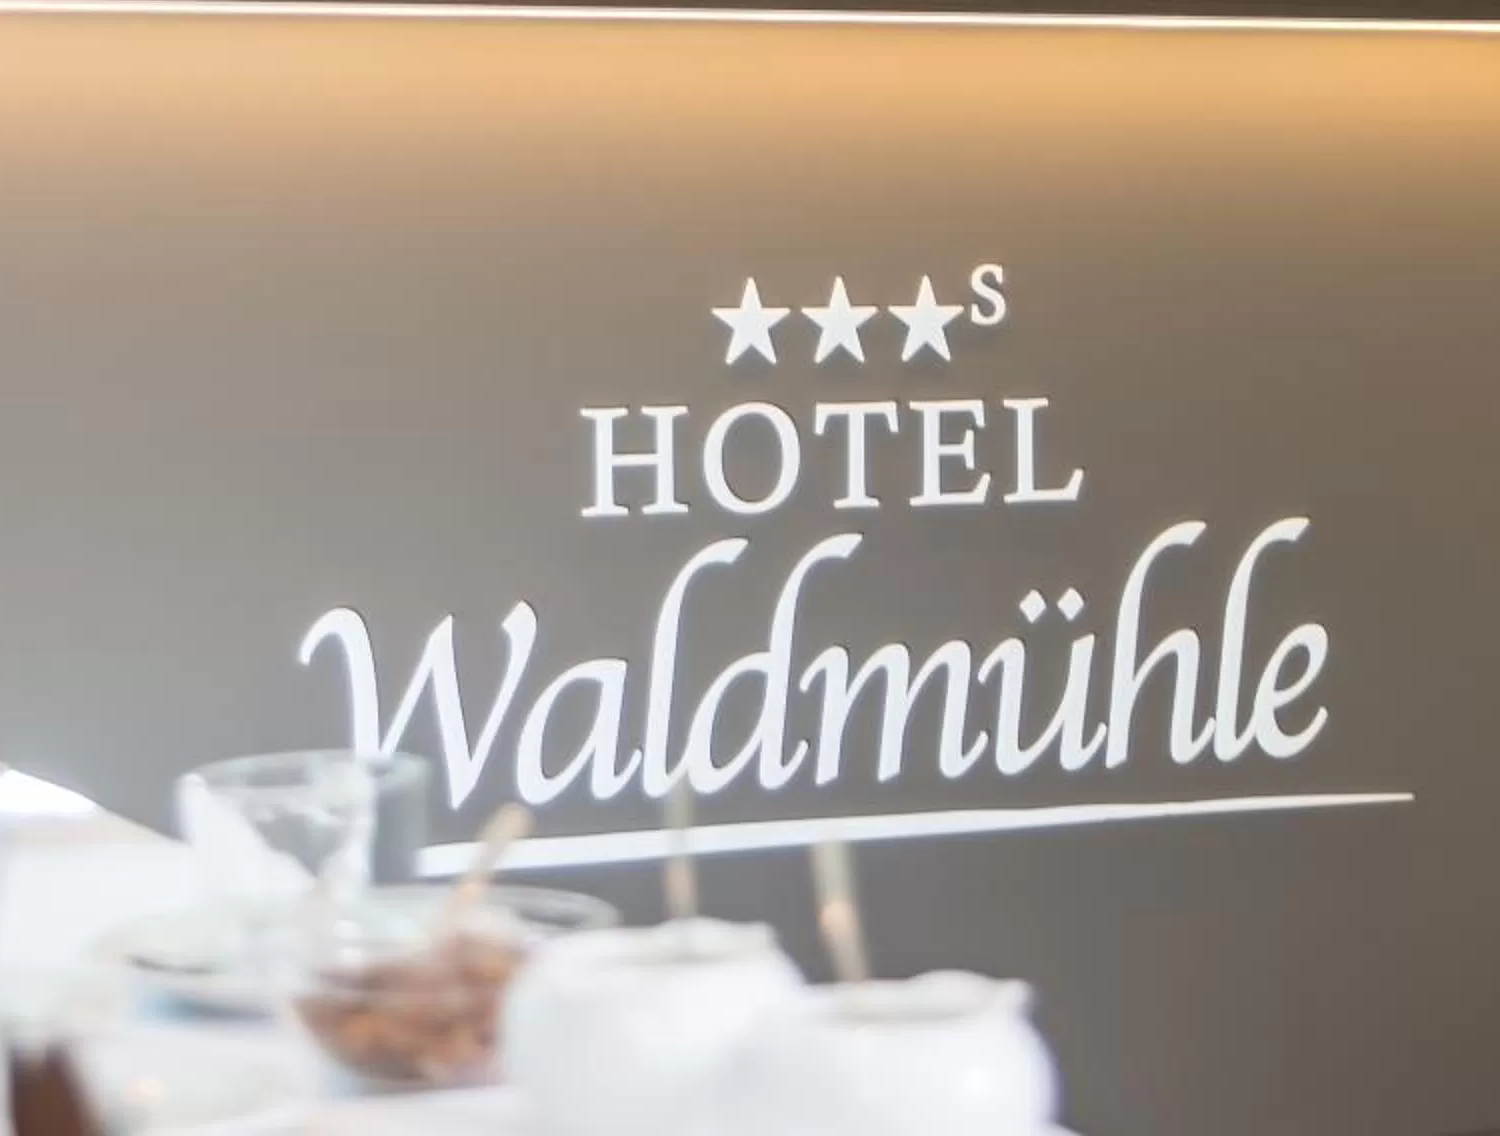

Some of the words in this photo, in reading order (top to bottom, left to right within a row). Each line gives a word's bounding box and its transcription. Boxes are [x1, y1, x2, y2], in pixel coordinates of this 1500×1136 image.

[969, 264, 1007, 325] S
[579, 397, 1085, 517] HOTEL
[299, 516, 1330, 809] Waldmühle
